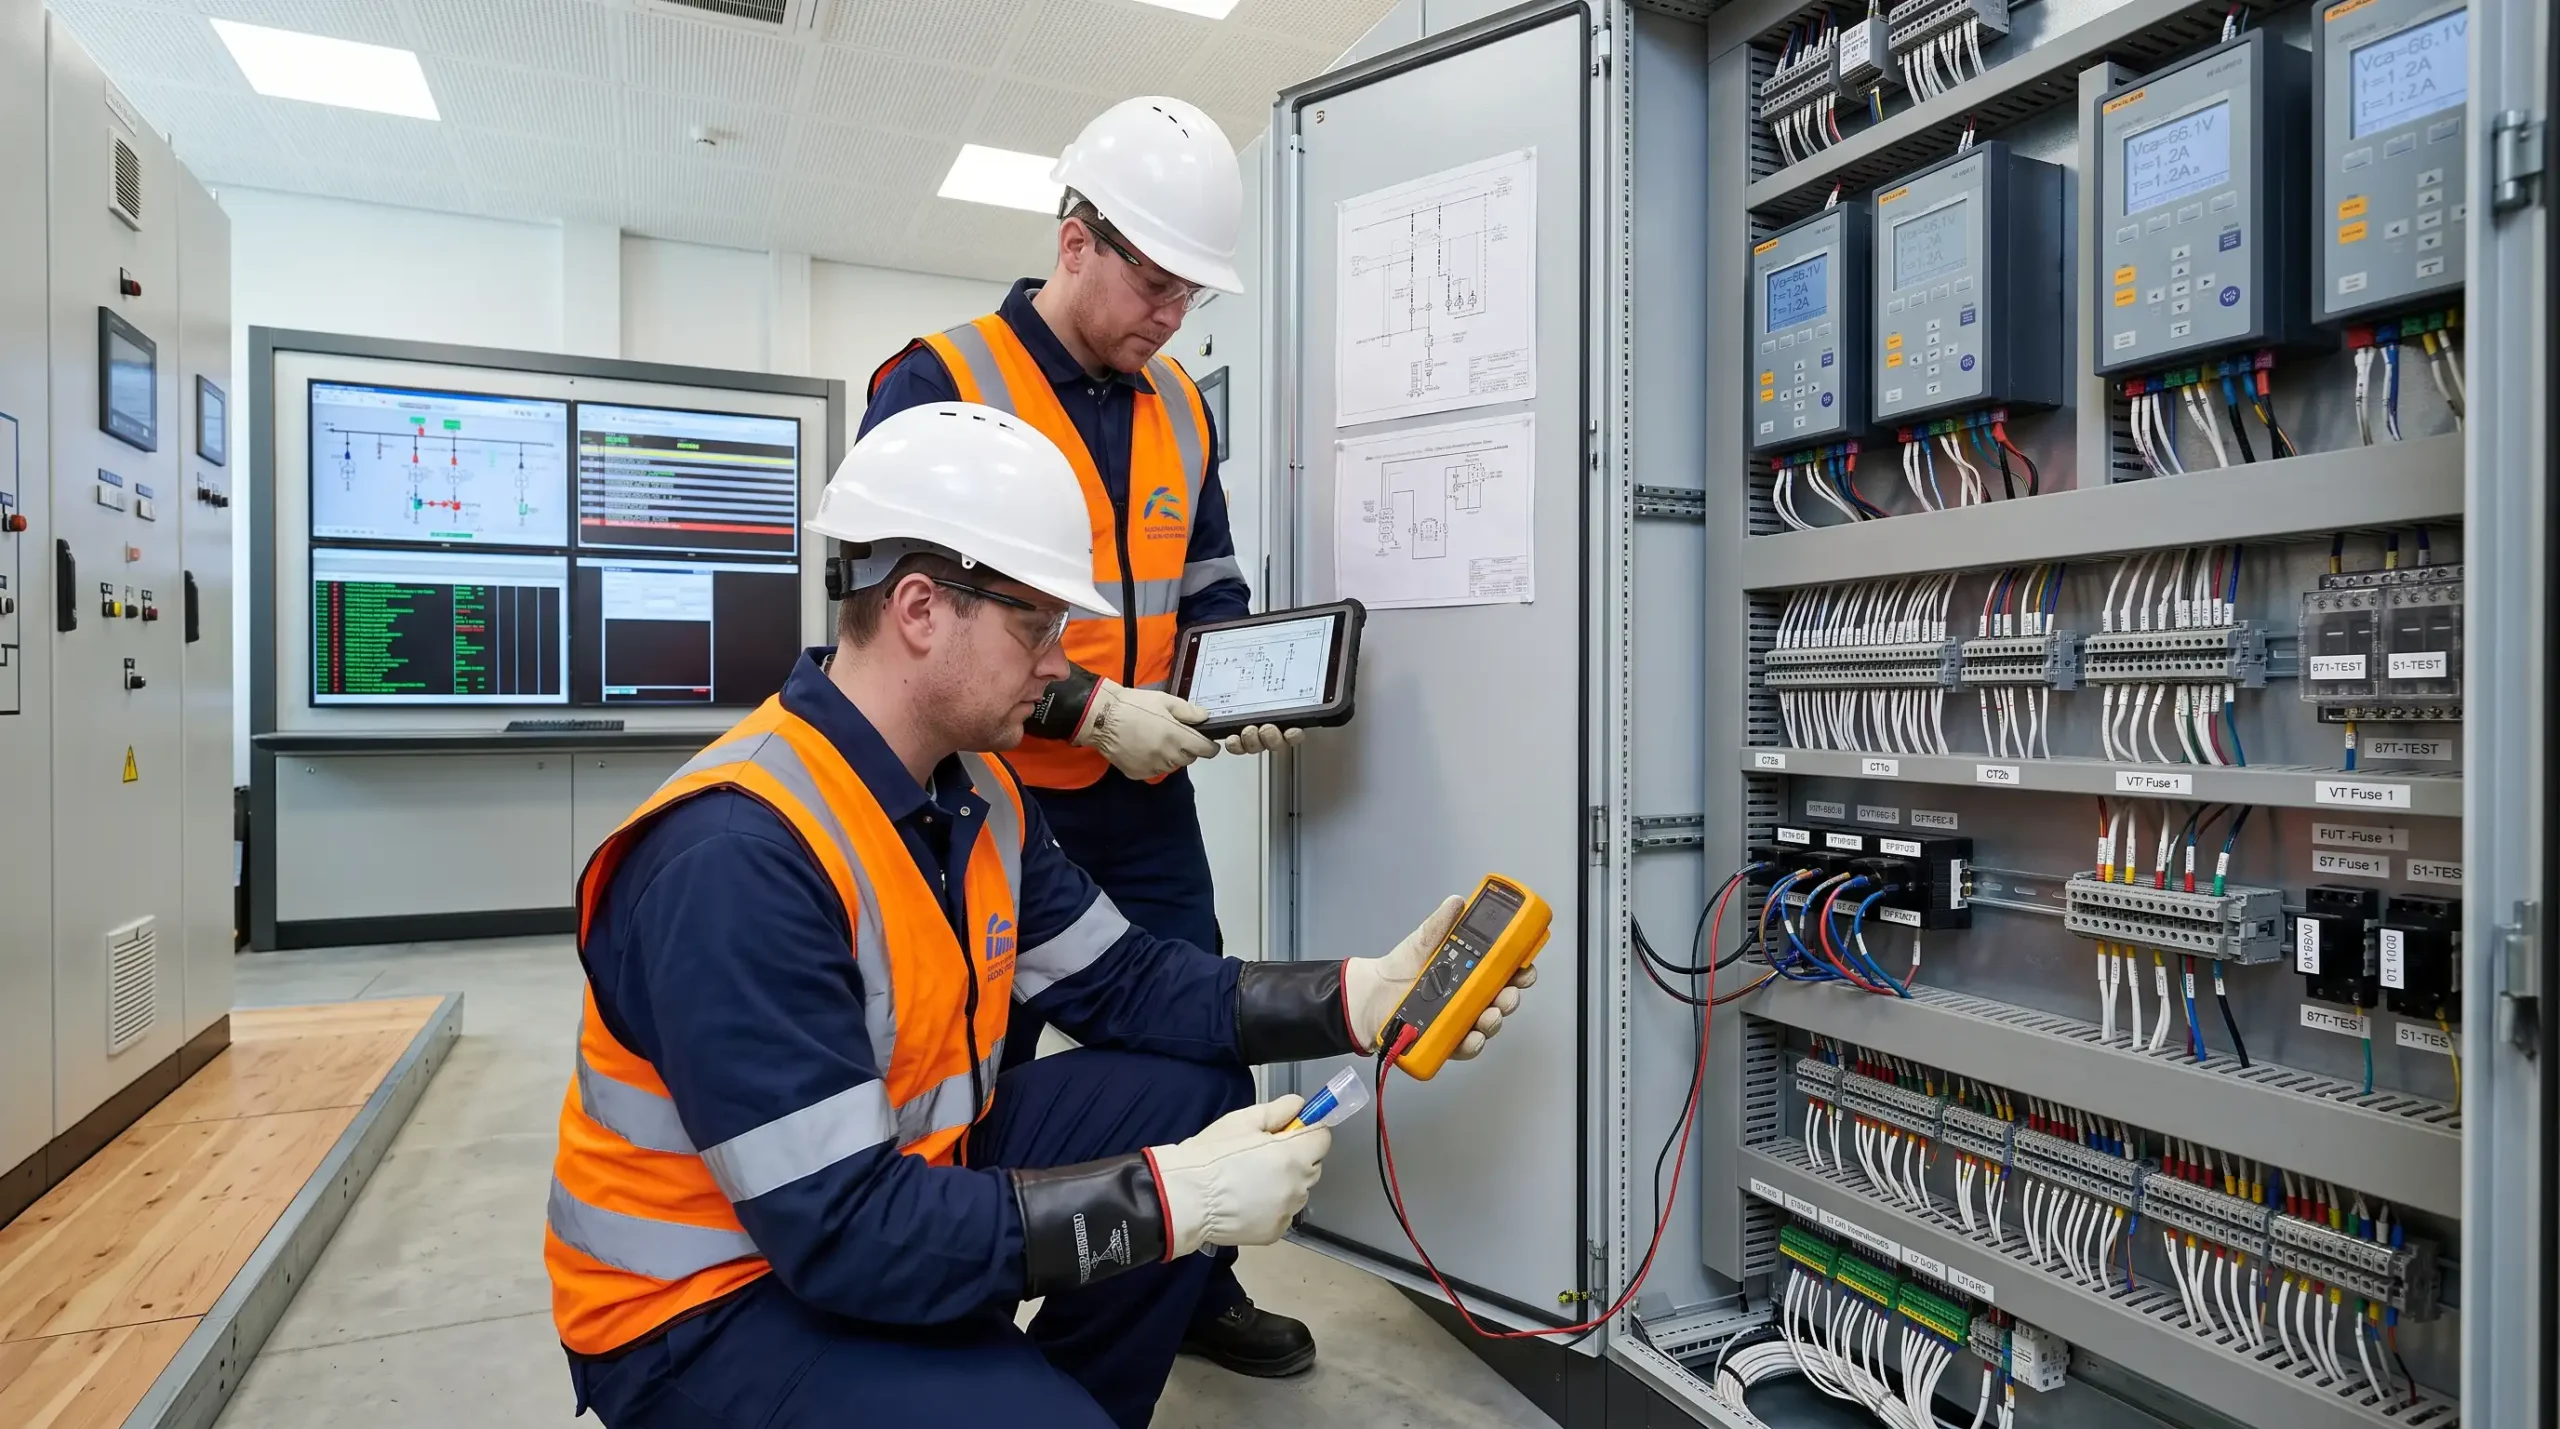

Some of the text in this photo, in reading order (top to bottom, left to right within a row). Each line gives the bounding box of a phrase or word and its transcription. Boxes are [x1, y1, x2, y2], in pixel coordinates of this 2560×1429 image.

[2374, 742, 2440, 755] 87T-TEST
[2146, 777, 2171, 788] Fuse
[2174, 779, 2179, 789] 1
[2329, 786, 2394, 801] VT Fuse 1
[2389, 834, 2394, 844] 1
[2338, 858, 2370, 871] Fuse
[2374, 861, 2380, 871] 1
[2413, 864, 2463, 879] 51-TES
[2307, 1011, 2358, 1031] 87T-TES
